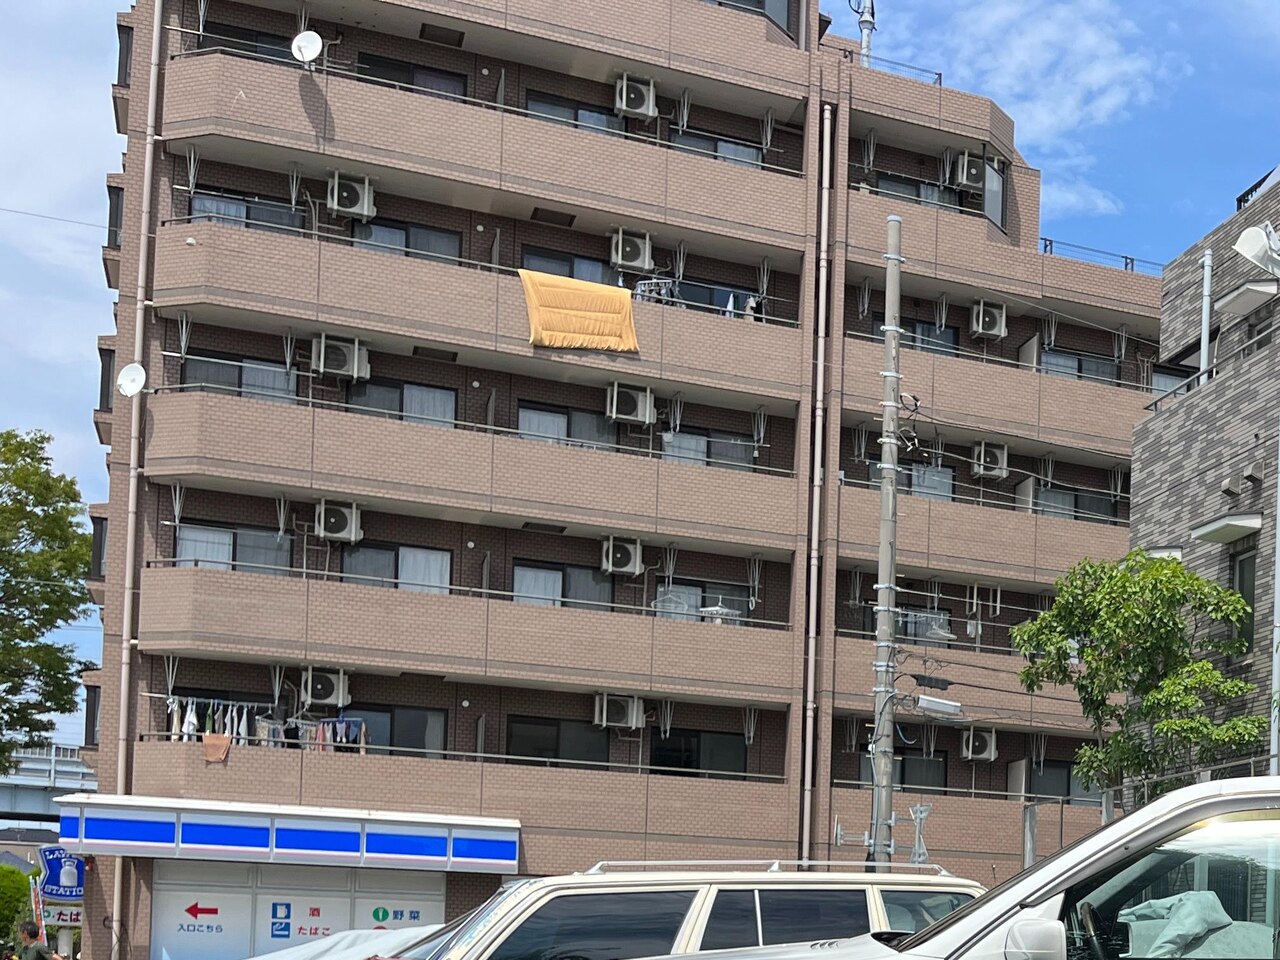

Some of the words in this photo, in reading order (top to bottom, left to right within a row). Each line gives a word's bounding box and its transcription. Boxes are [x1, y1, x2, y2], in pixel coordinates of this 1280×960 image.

[44, 885, 84, 896] STATIO
[309, 907, 320, 917] 酒
[392, 910, 420, 921] 野菜
[177, 923, 223, 933] 入口こちら
[297, 926, 331, 936] たばこ
